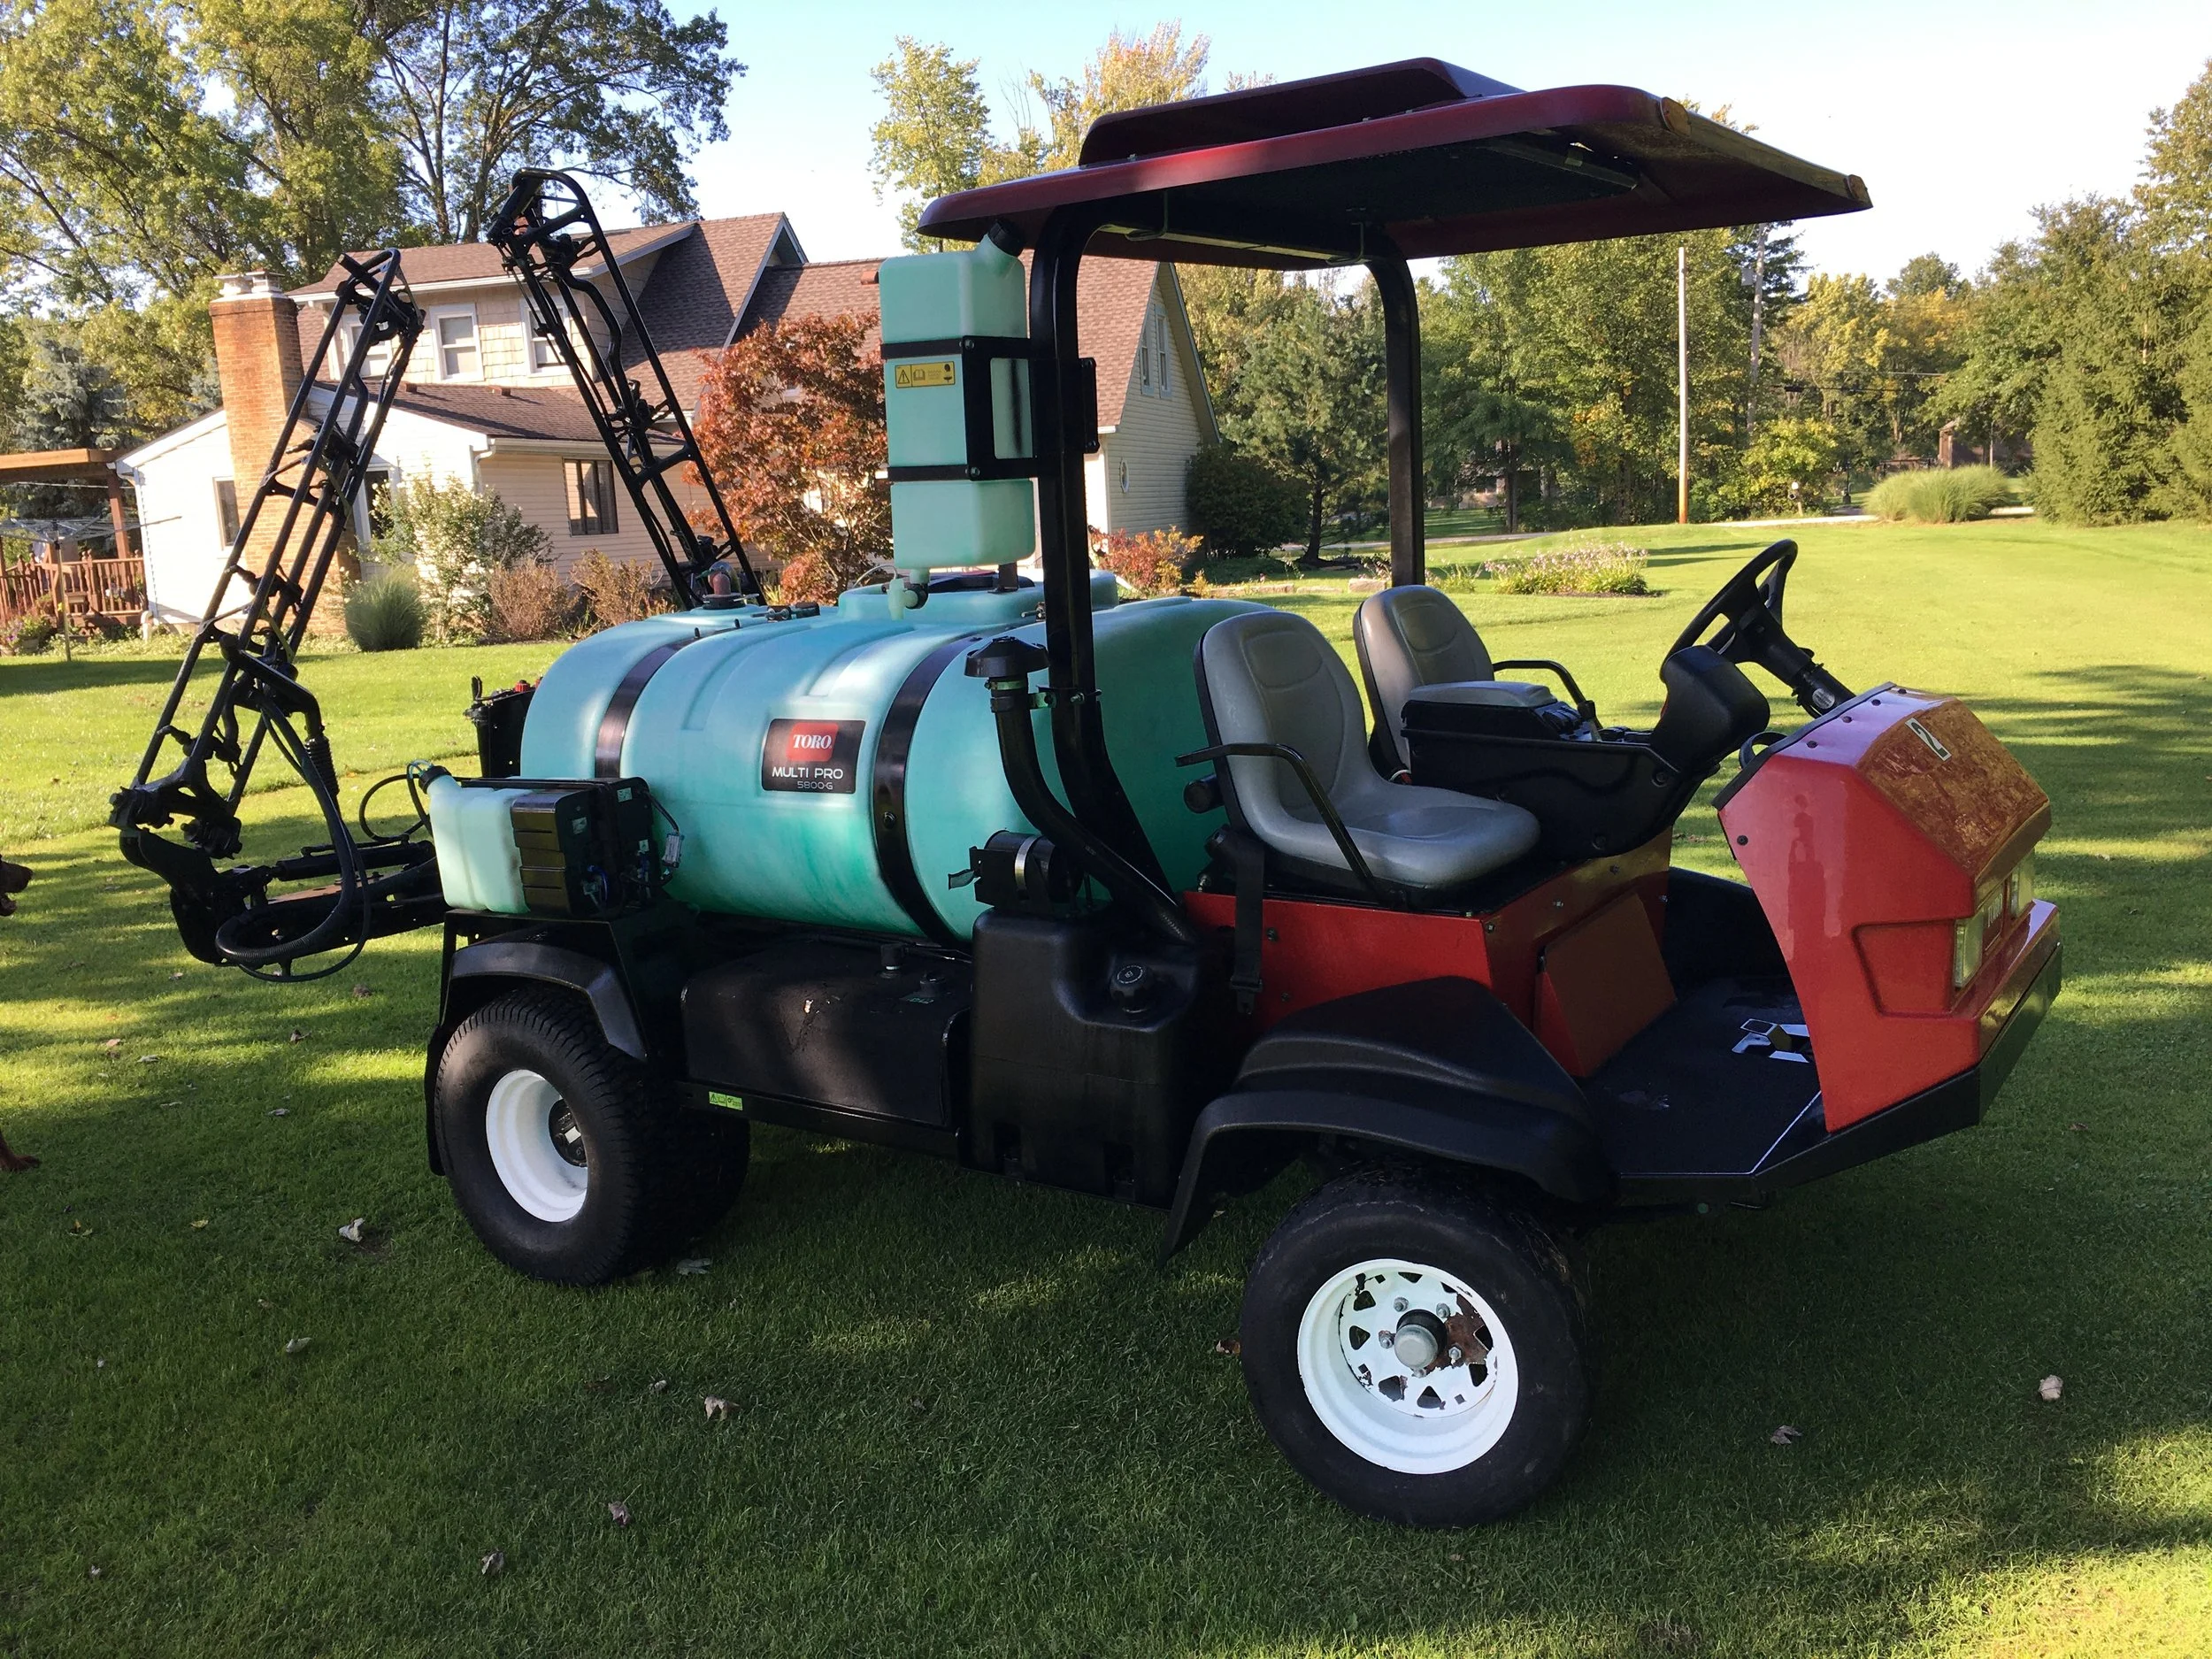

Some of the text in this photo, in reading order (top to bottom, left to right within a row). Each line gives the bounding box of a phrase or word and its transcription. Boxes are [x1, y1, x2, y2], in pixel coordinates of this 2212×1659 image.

[793, 734, 833, 749] TORO
[1910, 721, 1948, 758] 2
[772, 767, 844, 780] MULTI PRO
